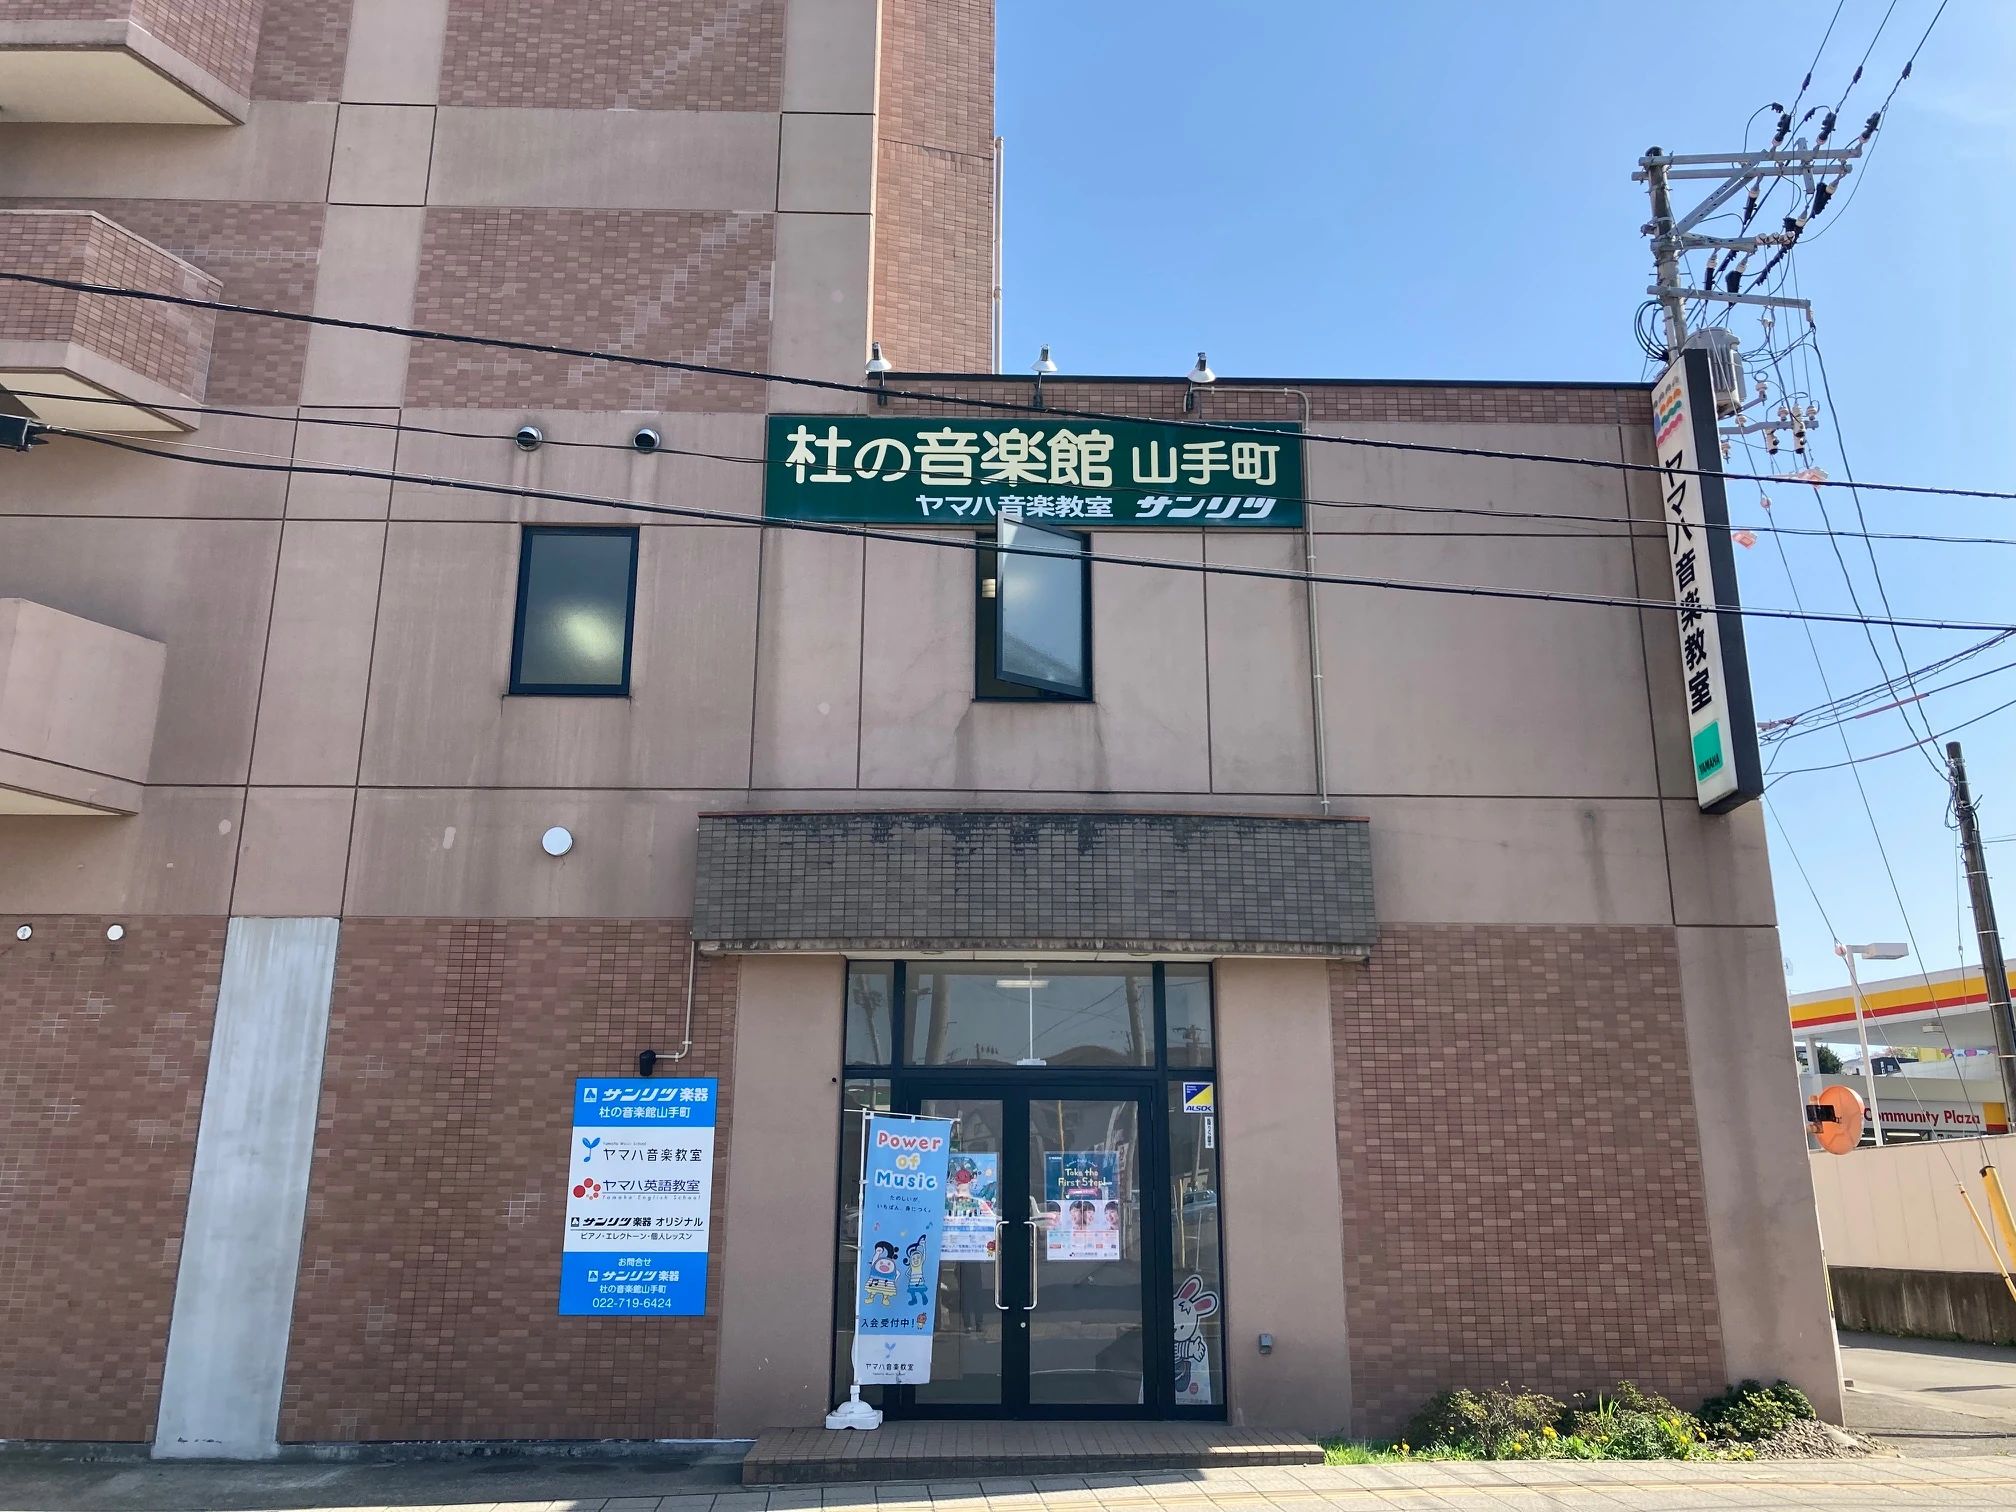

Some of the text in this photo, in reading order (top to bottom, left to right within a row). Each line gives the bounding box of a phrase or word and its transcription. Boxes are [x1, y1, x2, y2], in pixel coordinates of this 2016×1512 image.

[785, 424, 1280, 488] 杜の音楽館 山手町
[915, 494, 1277, 519] ヤマハ音楽教室 サンリツ
[1661, 448, 1713, 716] ヤマハ音楽教室
[602, 1087, 709, 1102] サンリツ楽器
[598, 1106, 691, 1119] 杜の音楽館山手町
[1864, 1107, 1981, 1127] Cmmunity Plaza
[877, 1130, 942, 1151] Power
[602, 1148, 703, 1162] ヤマハ音楽教室
[897, 1154, 921, 1170] of
[1064, 1167, 1099, 1177] Take the
[602, 1179, 701, 1192] ヤマハ英語教室
[876, 1170, 937, 1190] Music
[1058, 1177, 1081, 1187] First
[582, 1217, 704, 1227] サンリツ楽器 オリジナル
[617, 1257, 652, 1267] お問合せ
[601, 1270, 680, 1282] サンリツ楽器
[599, 1284, 667, 1294] 杜の音楽館山手町
[592, 1297, 672, 1308] 022-719-6424
[865, 1363, 915, 1372] ヤマハ音楽教室
